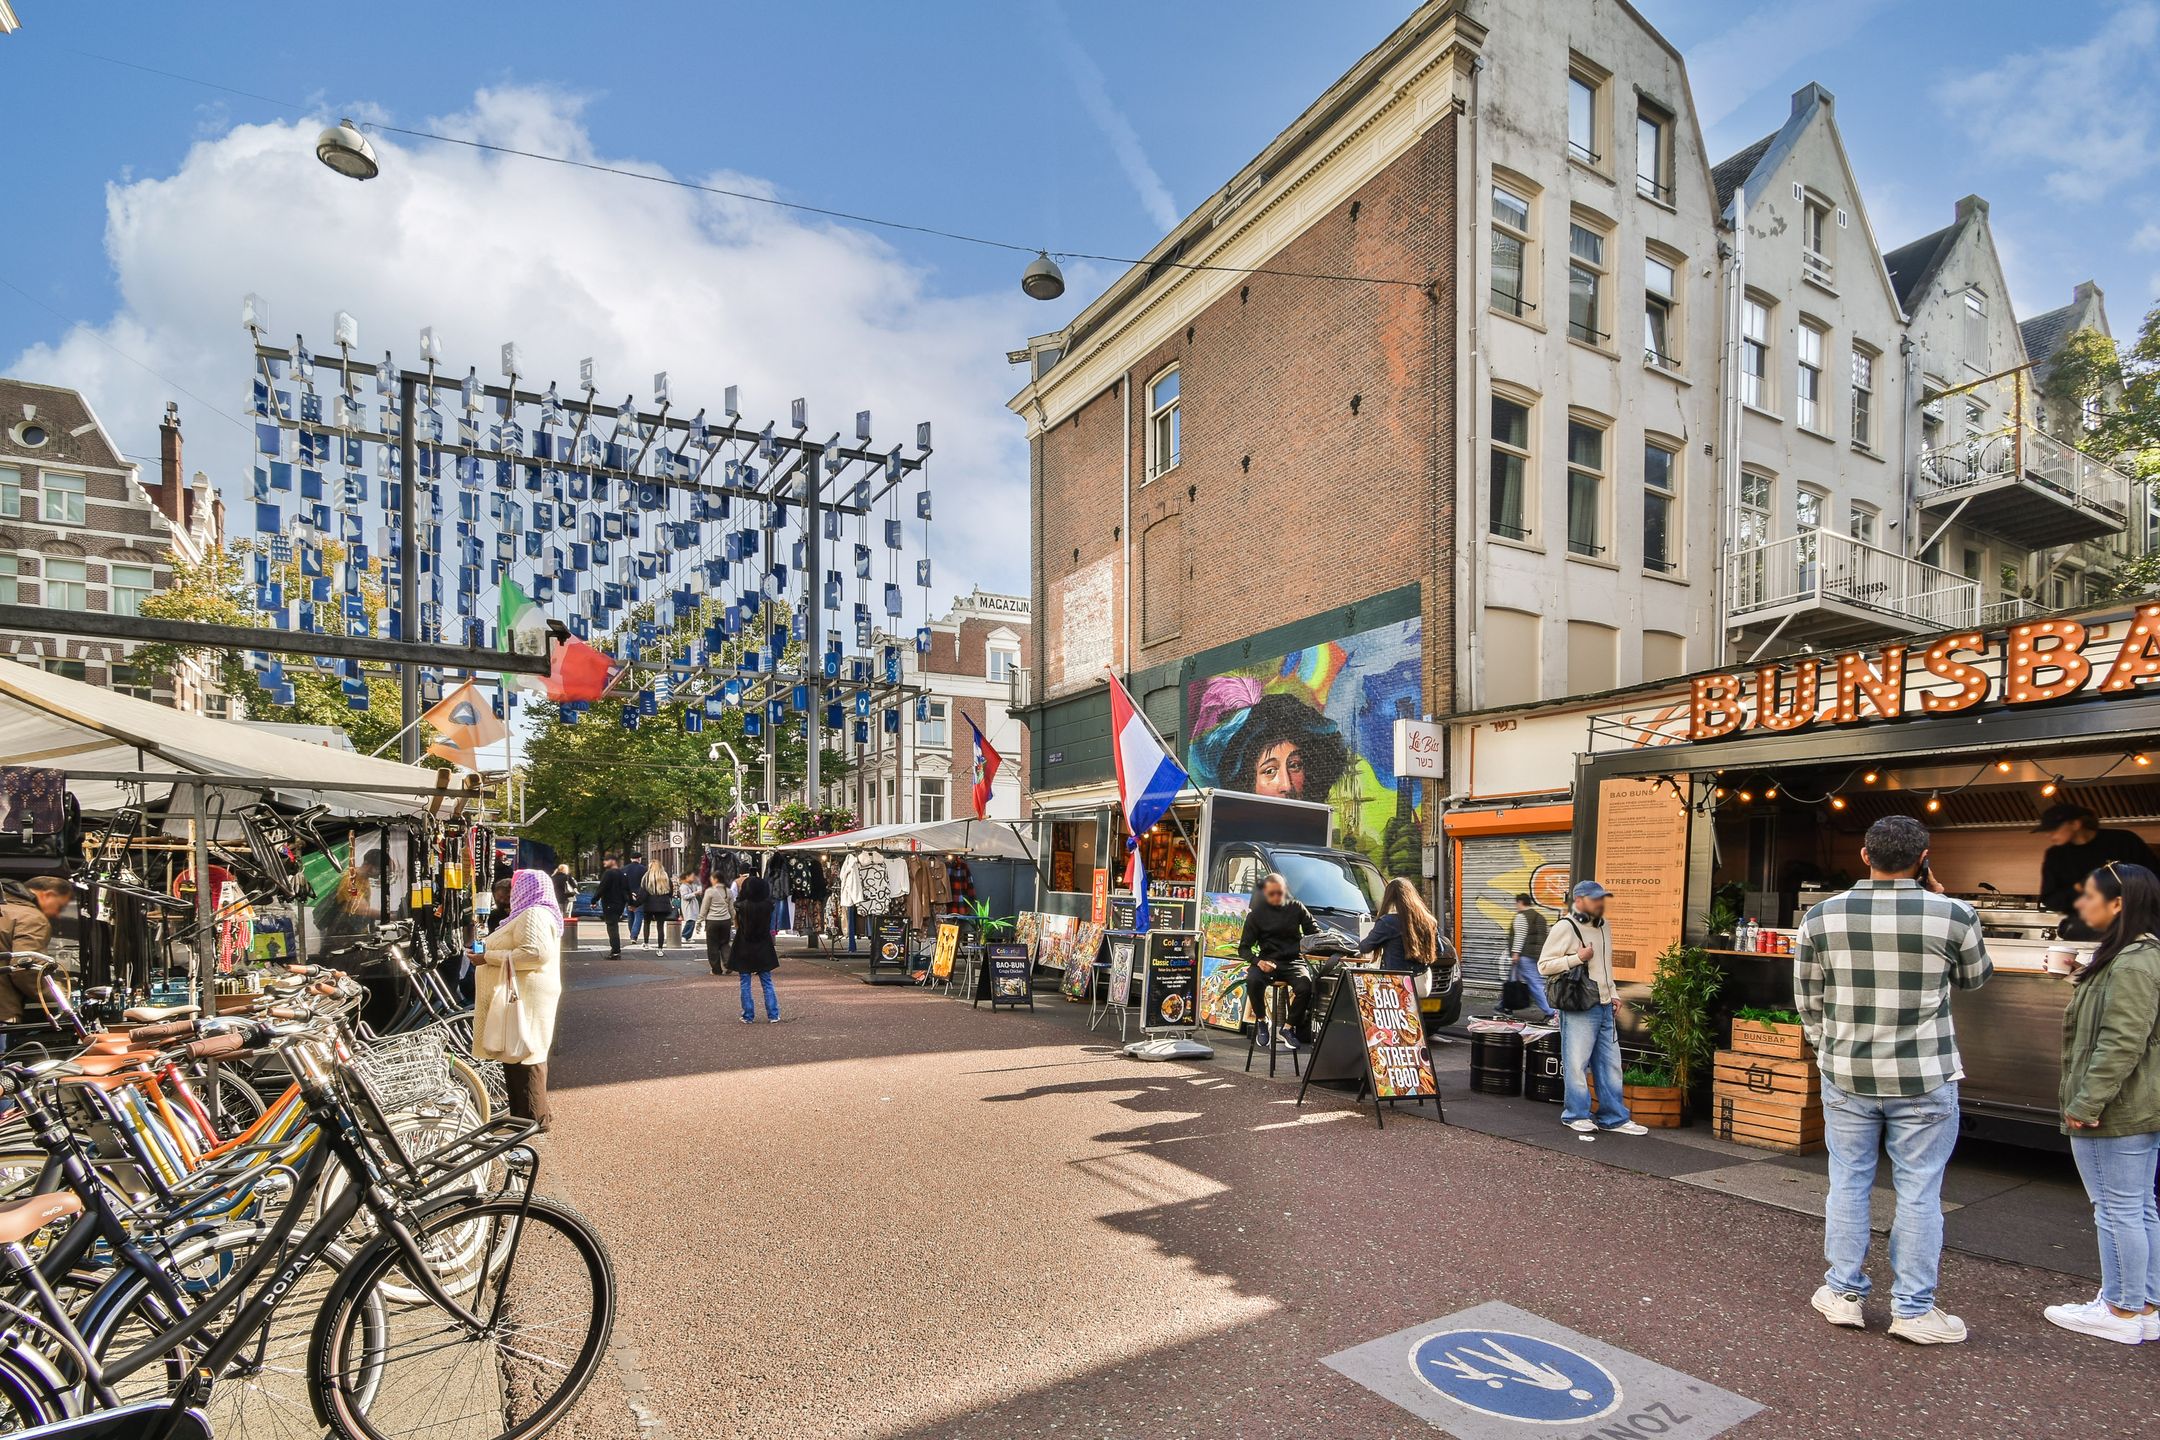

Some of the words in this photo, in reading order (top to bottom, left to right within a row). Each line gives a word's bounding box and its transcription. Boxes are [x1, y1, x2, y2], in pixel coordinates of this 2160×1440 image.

[1609, 791, 1628, 799] BAO
[995, 961, 1025, 969] BAO-BUN
[1152, 958, 1169, 966] Classic
[1373, 988, 1400, 1009] BAO
[1373, 1008, 1409, 1030] BUNS
[1391, 1030, 1400, 1045] &
[1743, 1032, 1786, 1044] BUNSBAR
[1377, 1046, 1420, 1067] STREET
[1387, 1067, 1421, 1089] FOOD
[1744, 1062, 1775, 1095] 包
[262, 1251, 316, 1306] POPAL
[1580, 1401, 1694, 1440] ZON
